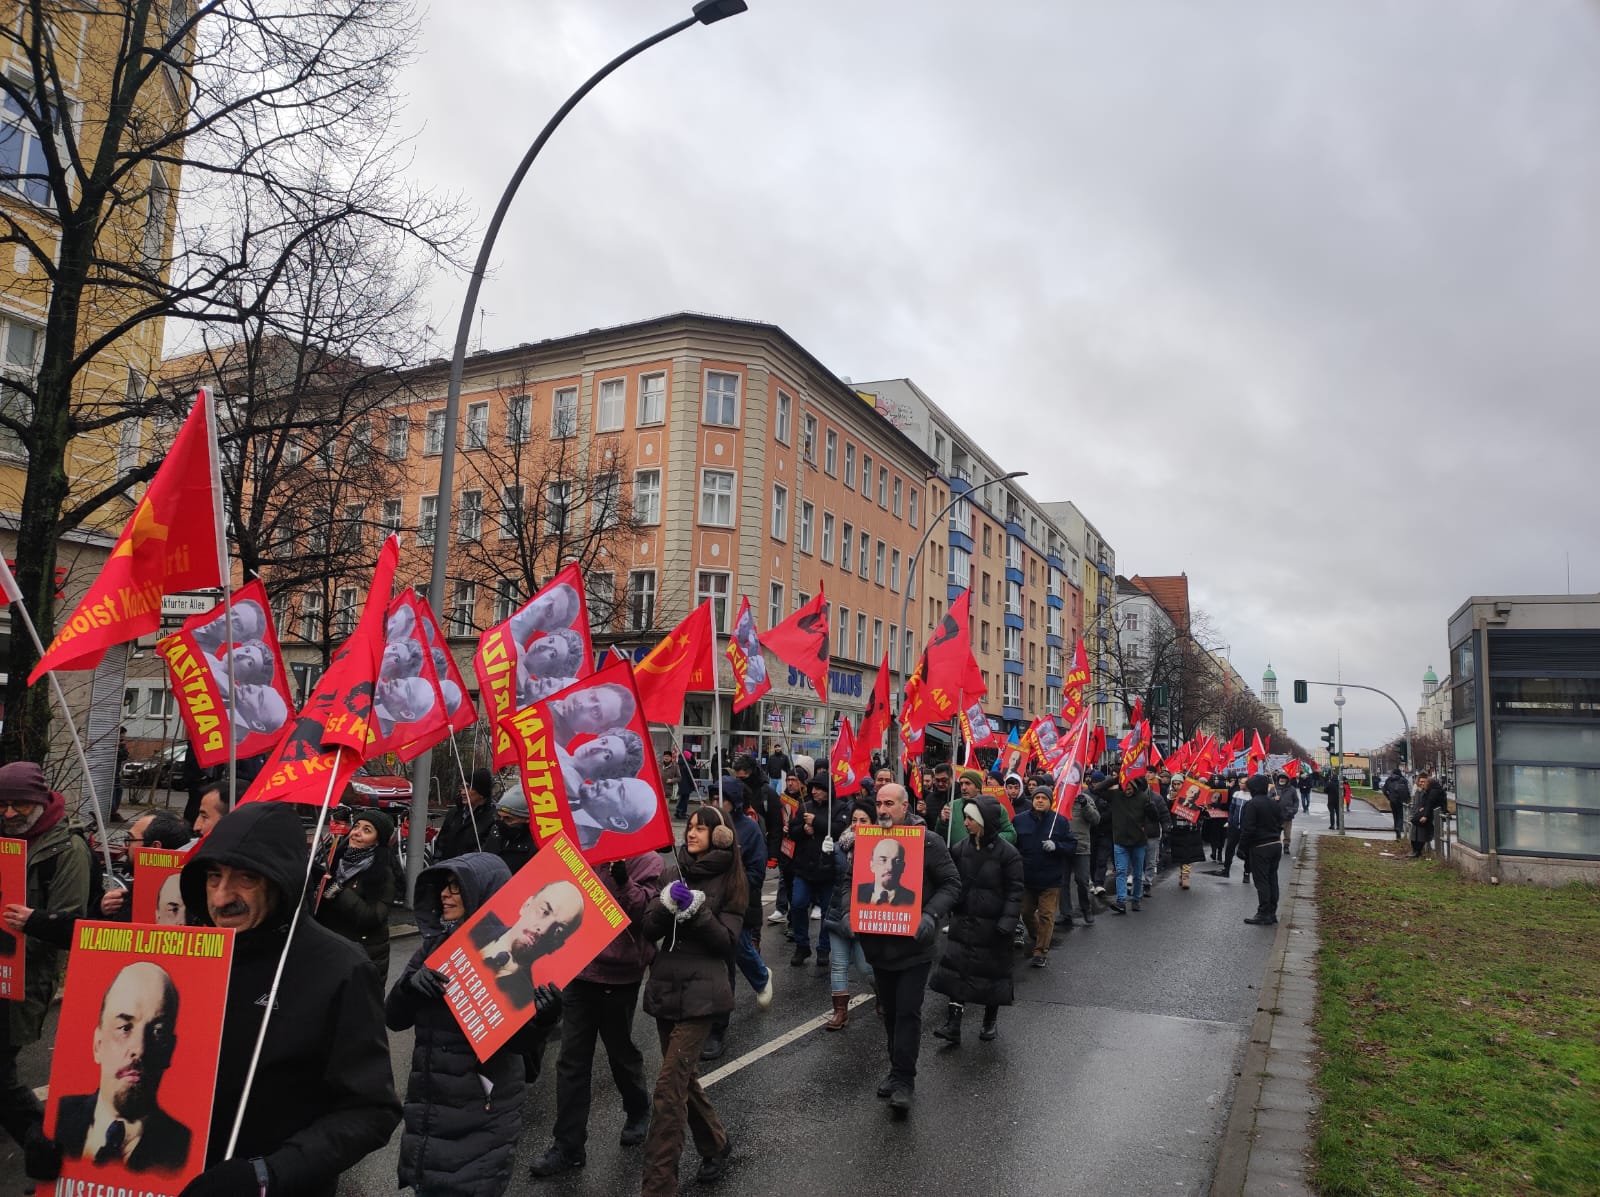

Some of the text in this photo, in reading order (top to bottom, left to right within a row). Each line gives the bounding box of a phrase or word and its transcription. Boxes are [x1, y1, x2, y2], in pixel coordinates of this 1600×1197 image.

[189, 597, 205, 610] Allee
[1, 842, 21, 855] LENIN
[139, 852, 173, 868] WLADIMIR
[552, 836, 624, 929] WLADIMIR ILJITSCH LENIN
[79, 927, 225, 958] WLADIMIR ILJITSCH LENIN
[449, 947, 505, 1030] UNSTERBLICH!
